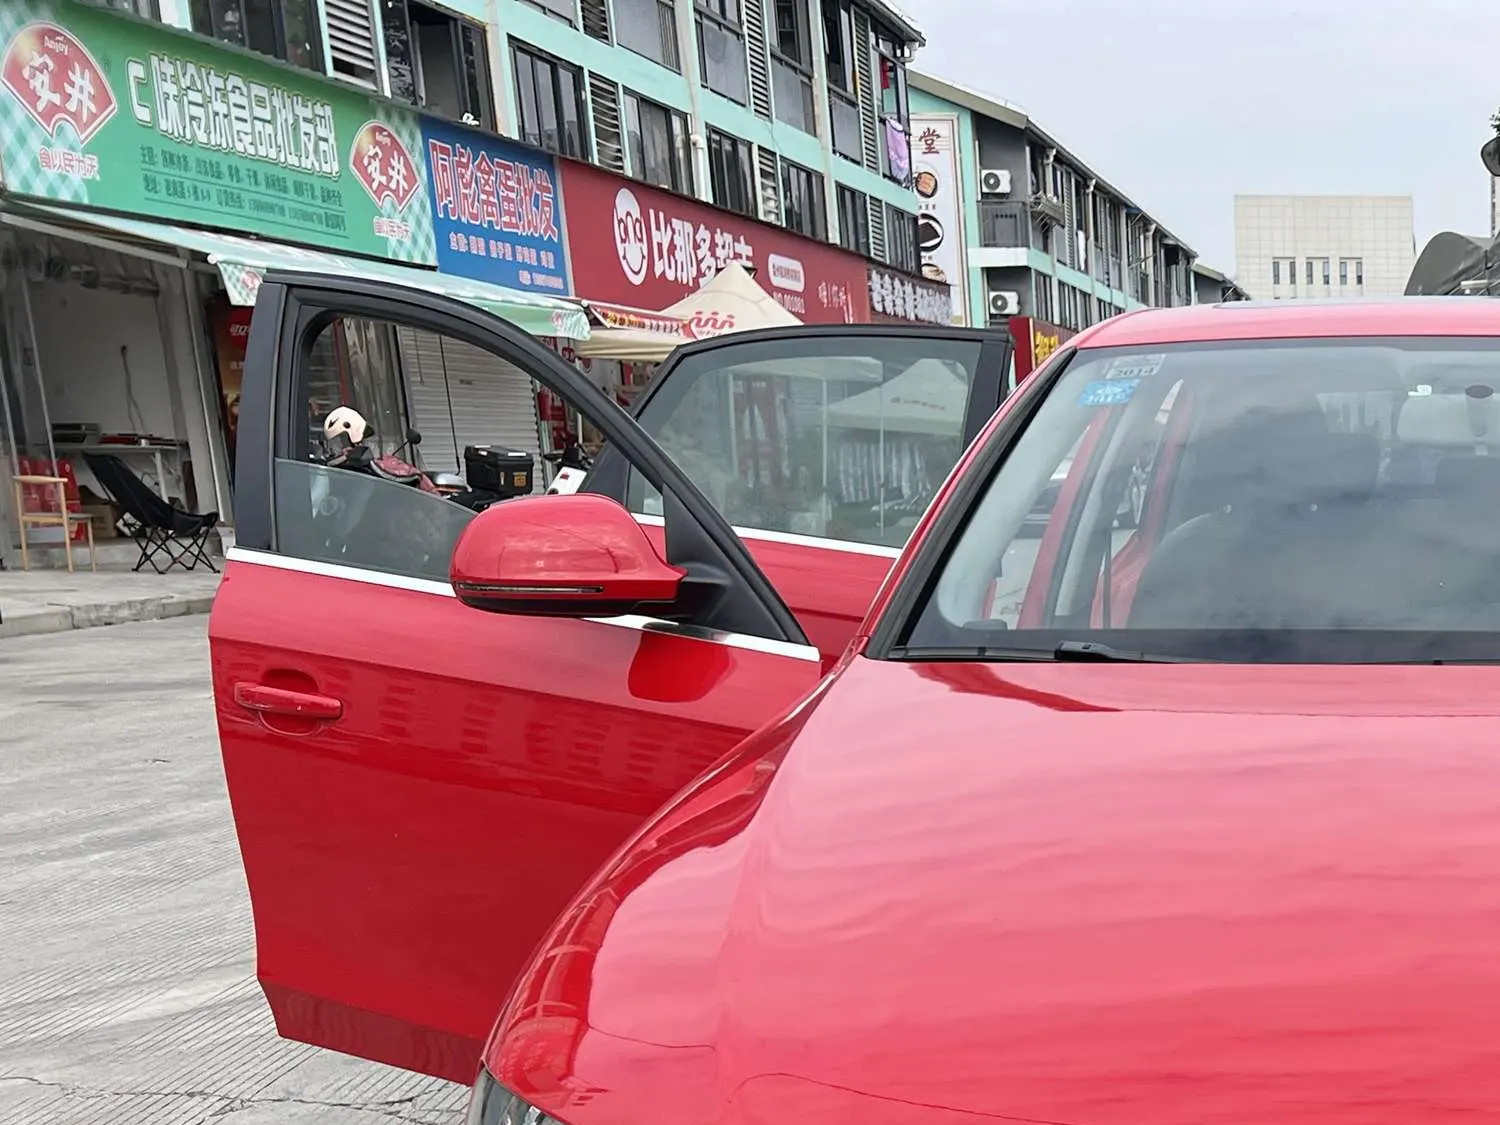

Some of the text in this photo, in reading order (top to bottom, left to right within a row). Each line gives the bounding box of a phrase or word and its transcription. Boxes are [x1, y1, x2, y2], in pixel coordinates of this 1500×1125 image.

[22, 51, 97, 124] 安井
[363, 144, 409, 198] 安井
[919, 127, 941, 155] 堂
[429, 138, 558, 243] 阿彪禽蛋批发
[649, 207, 754, 289] 比那多超市
